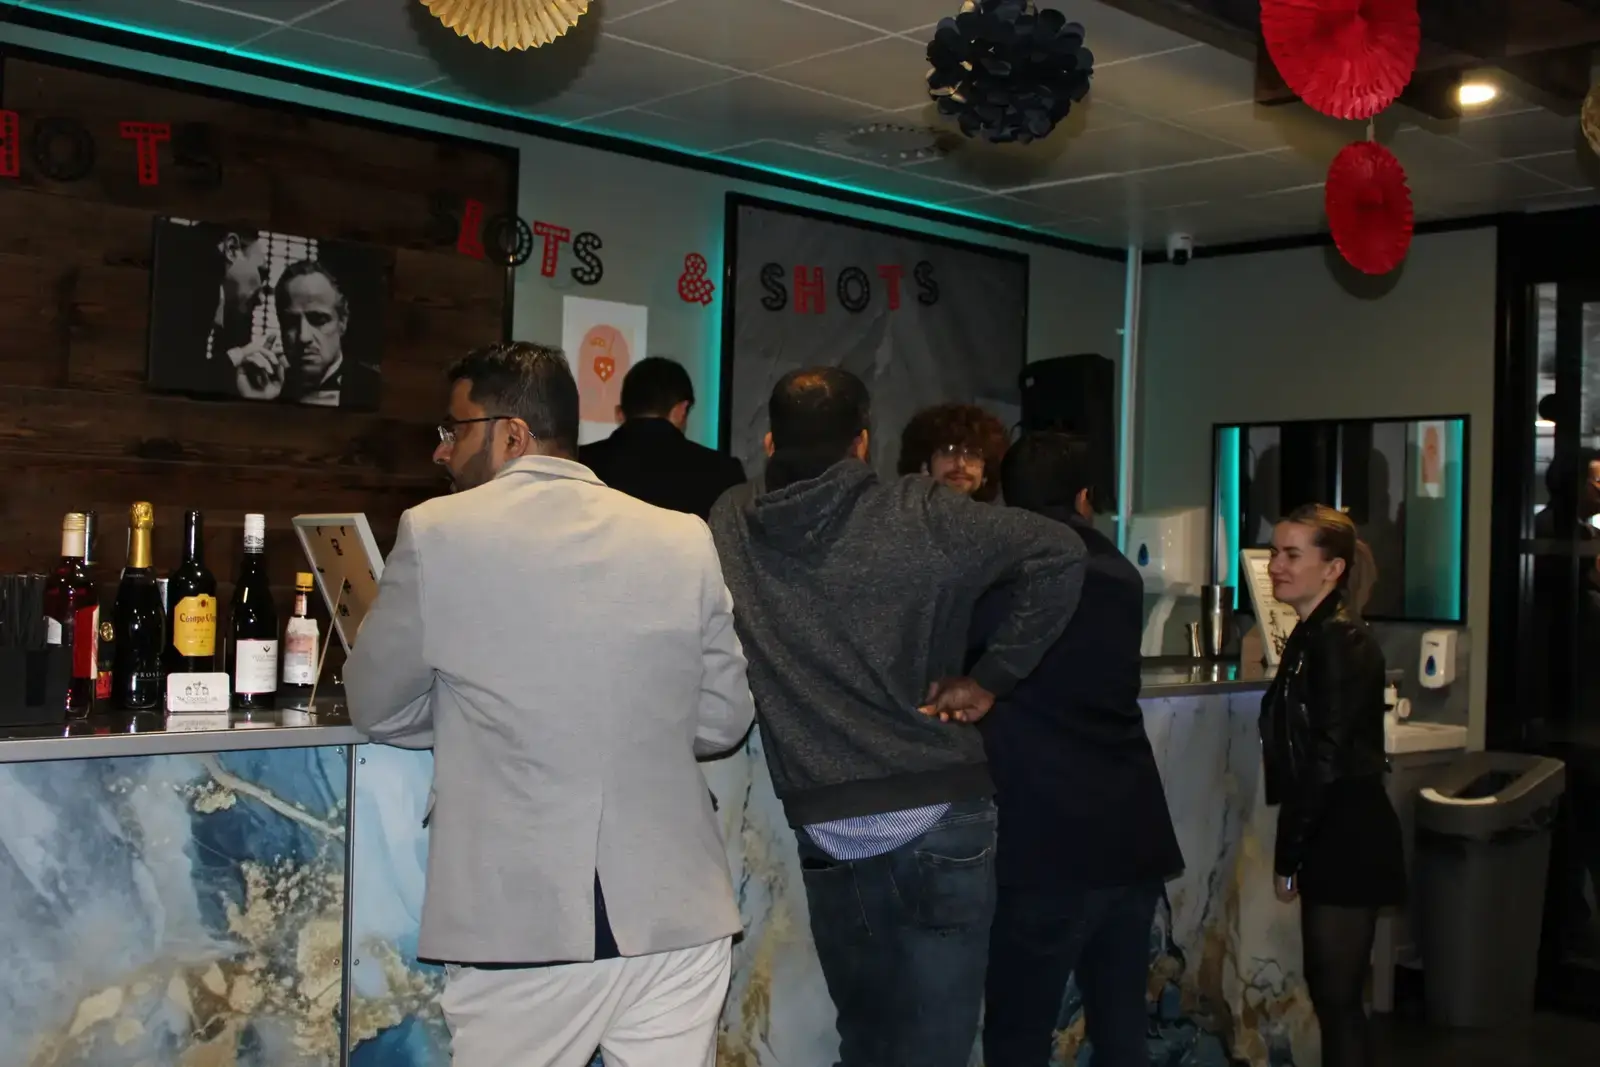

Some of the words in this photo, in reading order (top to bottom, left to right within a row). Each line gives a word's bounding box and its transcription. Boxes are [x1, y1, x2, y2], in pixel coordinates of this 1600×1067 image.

[425, 190, 603, 285] SLOTS
[677, 252, 715, 306] &
[760, 260, 938, 314] SHOTS
